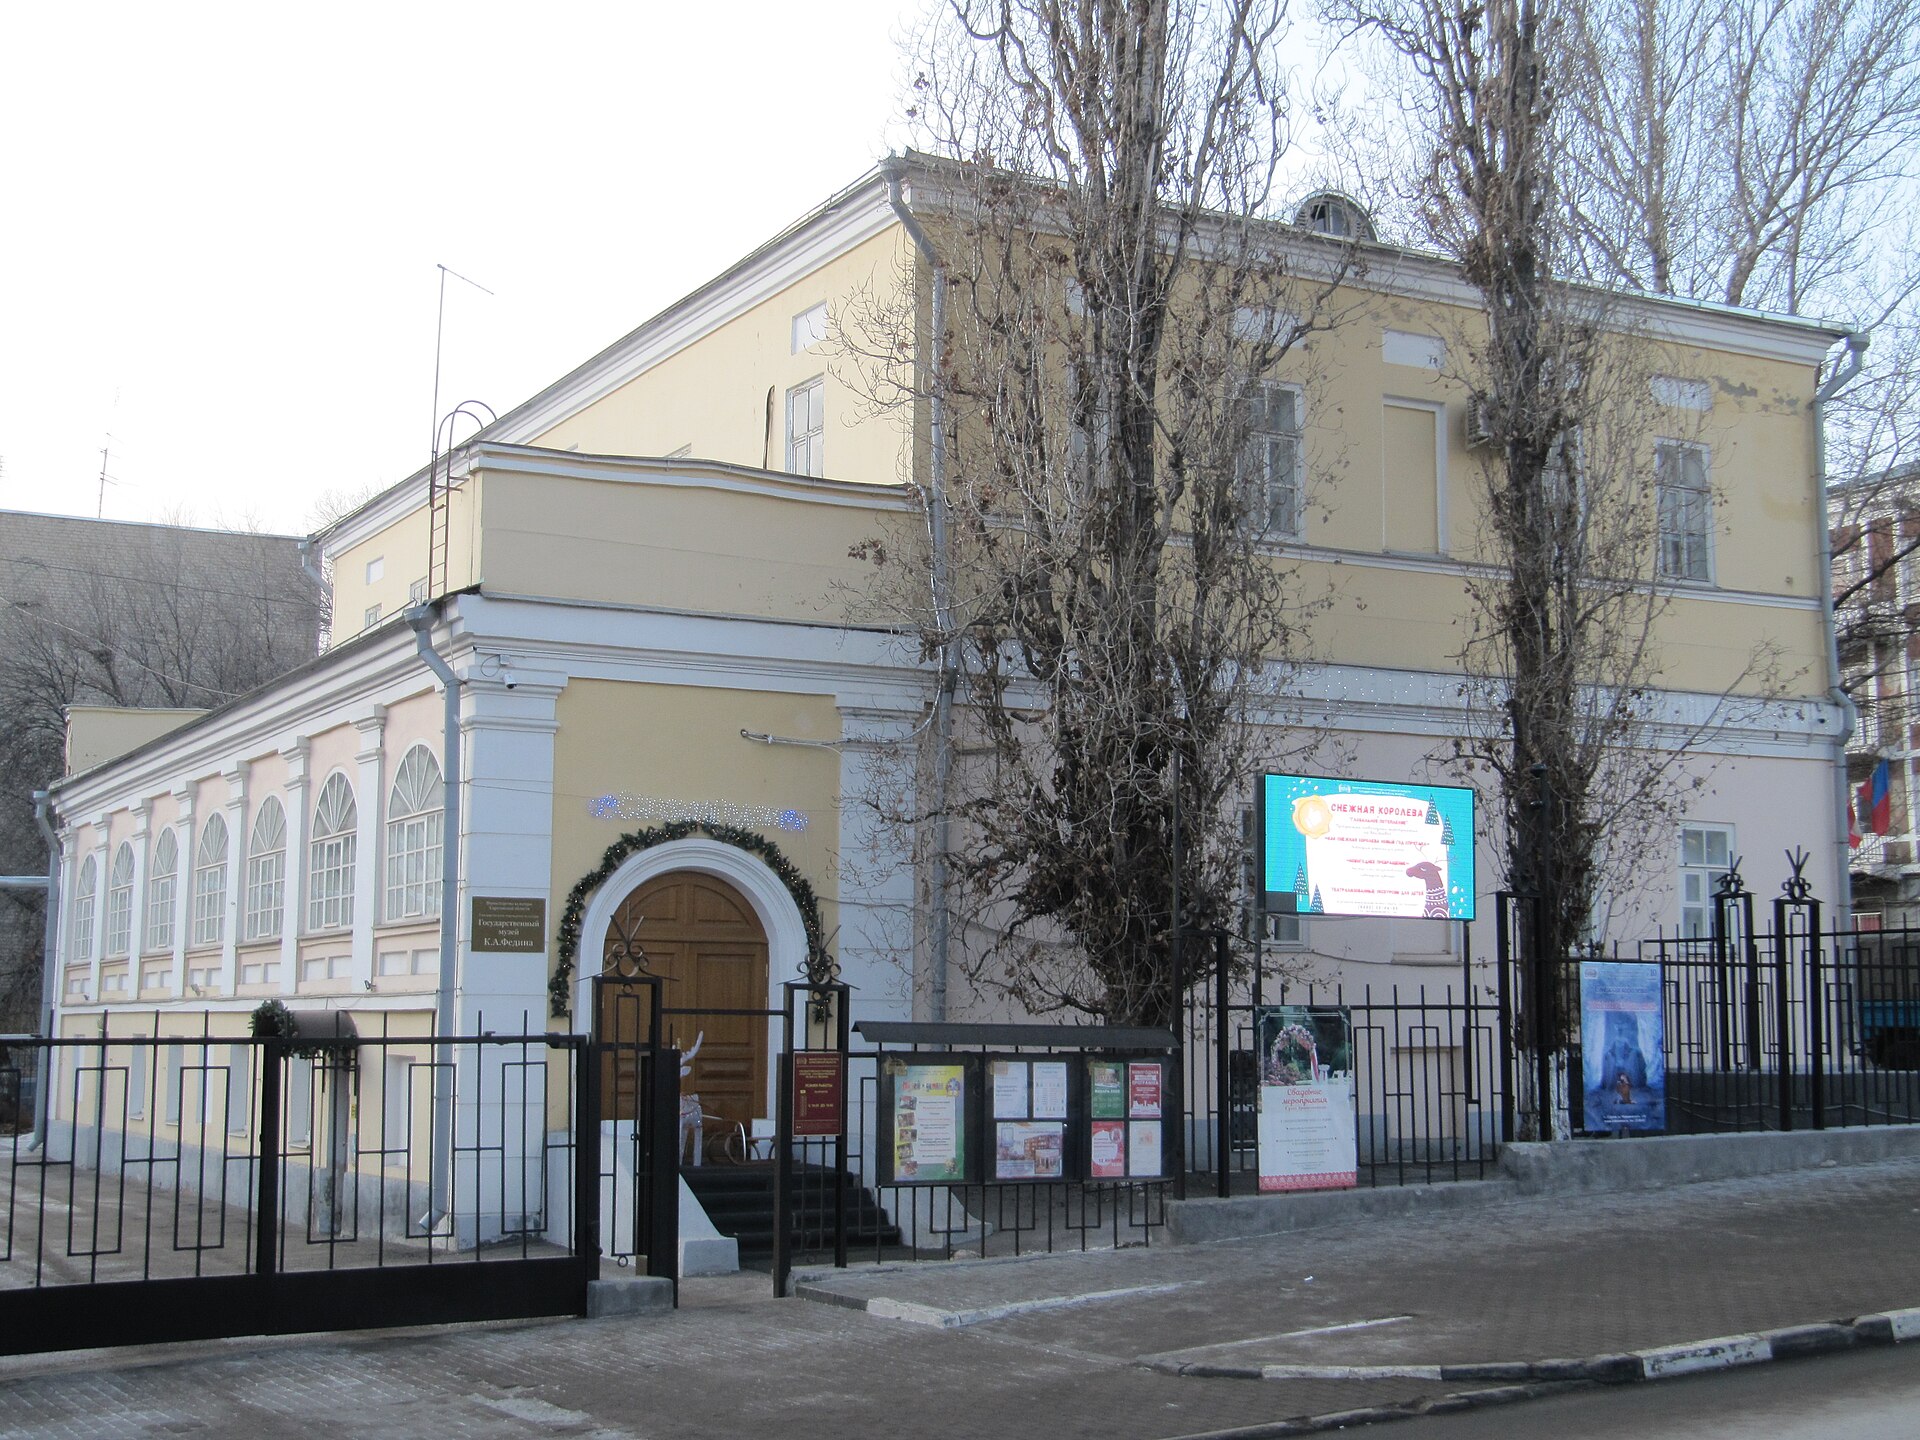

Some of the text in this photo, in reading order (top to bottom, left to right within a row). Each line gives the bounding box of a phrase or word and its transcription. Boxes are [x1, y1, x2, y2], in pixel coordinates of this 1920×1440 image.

[1331, 803, 1423, 817] СНЕЖНАЯ КОРОЛЕВА
[478, 918, 540, 928] Государственный
[498, 928, 520, 937] музей
[483, 937, 534, 947] К.А.Федина
